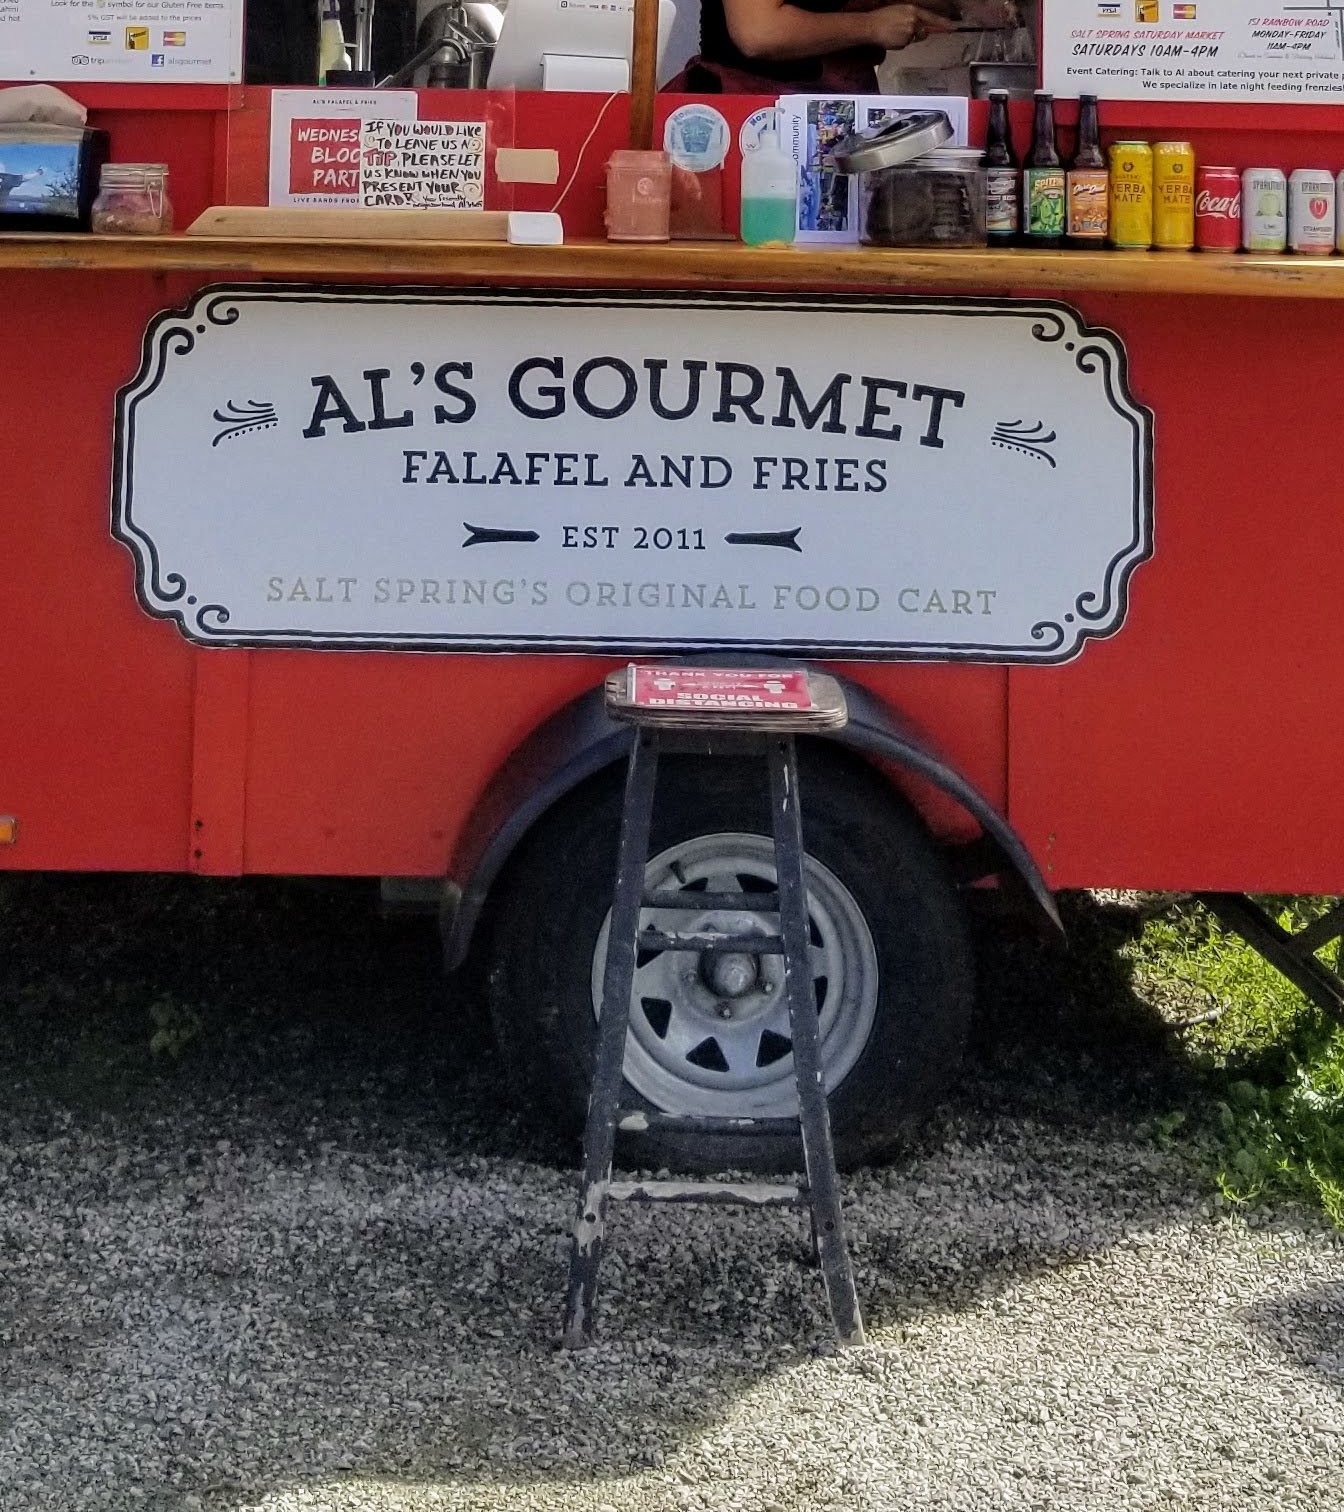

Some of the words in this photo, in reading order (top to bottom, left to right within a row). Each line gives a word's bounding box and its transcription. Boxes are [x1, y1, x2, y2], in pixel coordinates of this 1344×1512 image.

[1262, 18, 1303, 27] RAINBOW
[1305, 19, 1329, 27] ROAD
[1252, 30, 1326, 39] MONDAY-FRIDAY
[1072, 43, 1145, 57] SATURDAYS
[1150, 44, 1218, 57] 10AM-4PM
[1142, 81, 1156, 89] We
[1160, 81, 1205, 90] specialize
[1220, 81, 1237, 90] late
[1240, 82, 1264, 92] night
[1268, 82, 1301, 92] feeding
[1305, 83, 1344, 92] frenzies!
[298, 128, 360, 143] WEDNES
[387, 122, 410, 137] YOU
[413, 124, 454, 136] WOULD
[376, 138, 392, 149] TO
[396, 138, 438, 150] LEAVE
[442, 139, 457, 150] US
[401, 152, 456, 167] PLEASE
[458, 154, 482, 167] LET
[364, 169, 381, 179] US
[385, 168, 418, 179] KNOW
[422, 168, 459, 179] WHEN
[461, 170, 481, 181] YOU
[362, 181, 423, 194] PRESENT
[426, 181, 463, 194] YOUR
[302, 361, 476, 439] AL'S
[507, 355, 964, 450] GOURMET
[401, 450, 609, 487] FALAFEL
[624, 453, 733, 489] AND
[752, 456, 888, 493] FRIES
[562, 526, 618, 548] EST
[634, 527, 705, 550] 2011
[267, 576, 356, 602] SALT
[374, 577, 547, 606] SPRING'S
[566, 581, 756, 609] ORIGINAL
[773, 585, 879, 612] FOOD
[898, 588, 996, 615] CART
[649, 698, 798, 708] DISTANCING
[677, 692, 763, 702] SOCIAL
